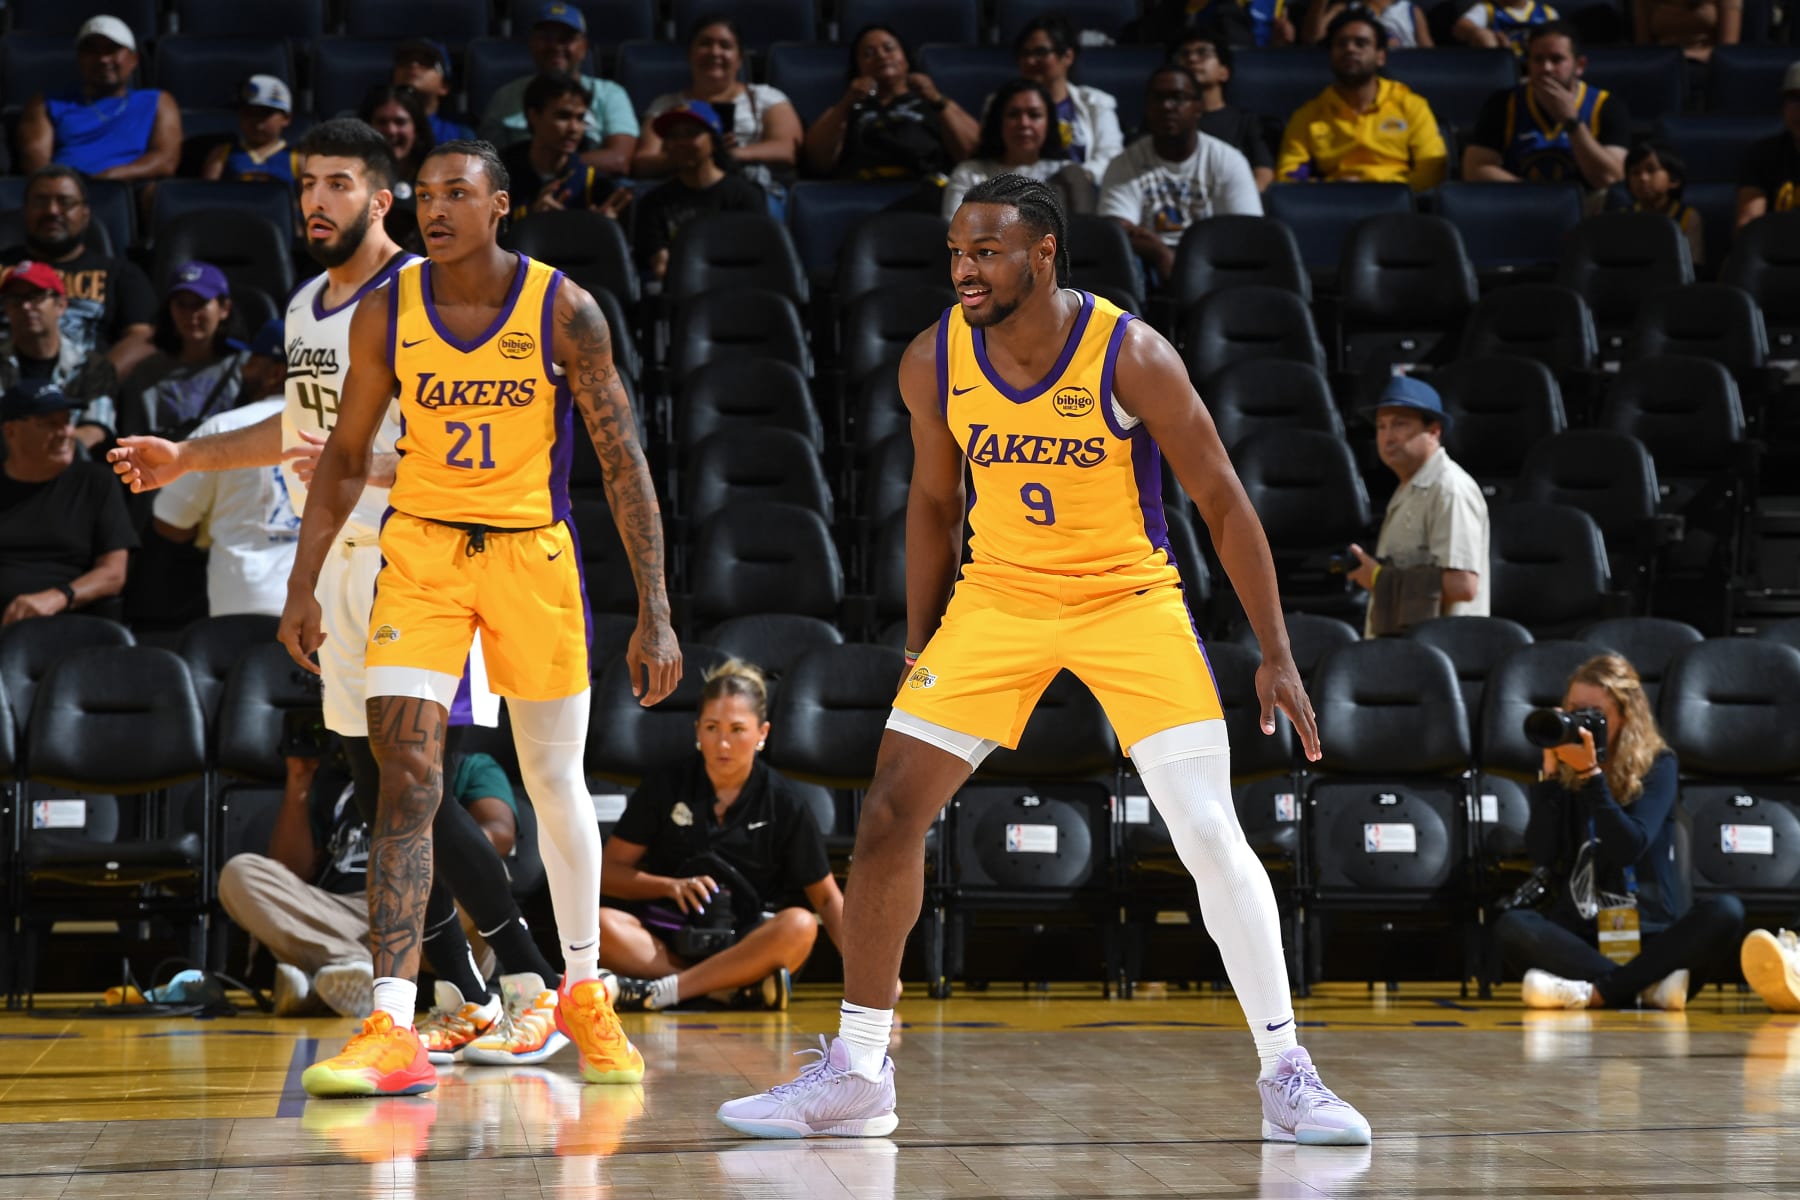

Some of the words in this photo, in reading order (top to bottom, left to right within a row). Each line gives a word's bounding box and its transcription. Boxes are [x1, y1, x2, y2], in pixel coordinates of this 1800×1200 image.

[502, 339, 533, 352] bibigo
[415, 372, 537, 410] LAKERS
[1057, 394, 1092, 409] bibigo
[445, 421, 496, 469] 21
[966, 424, 1108, 468] LAKERS
[1020, 482, 1056, 526] 9
